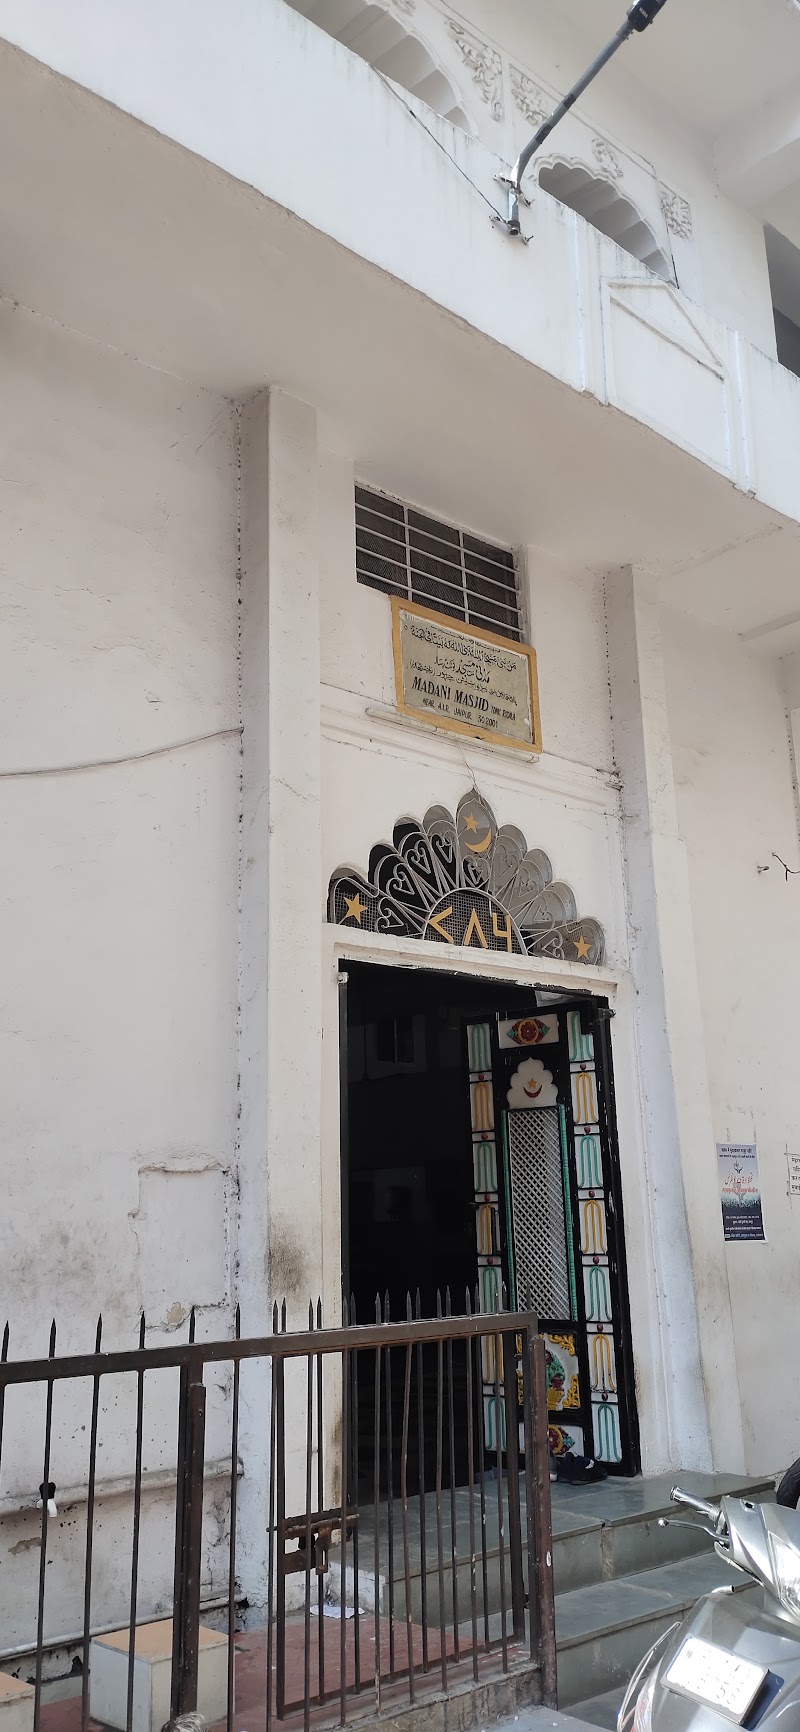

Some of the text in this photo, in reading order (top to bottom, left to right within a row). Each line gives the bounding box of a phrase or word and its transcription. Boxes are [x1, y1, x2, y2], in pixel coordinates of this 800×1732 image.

[411, 676, 451, 701] MADANI
[453, 689, 489, 712] MASJID
[423, 698, 434, 708] NEAR
[454, 707, 472, 720] JAIPUR
